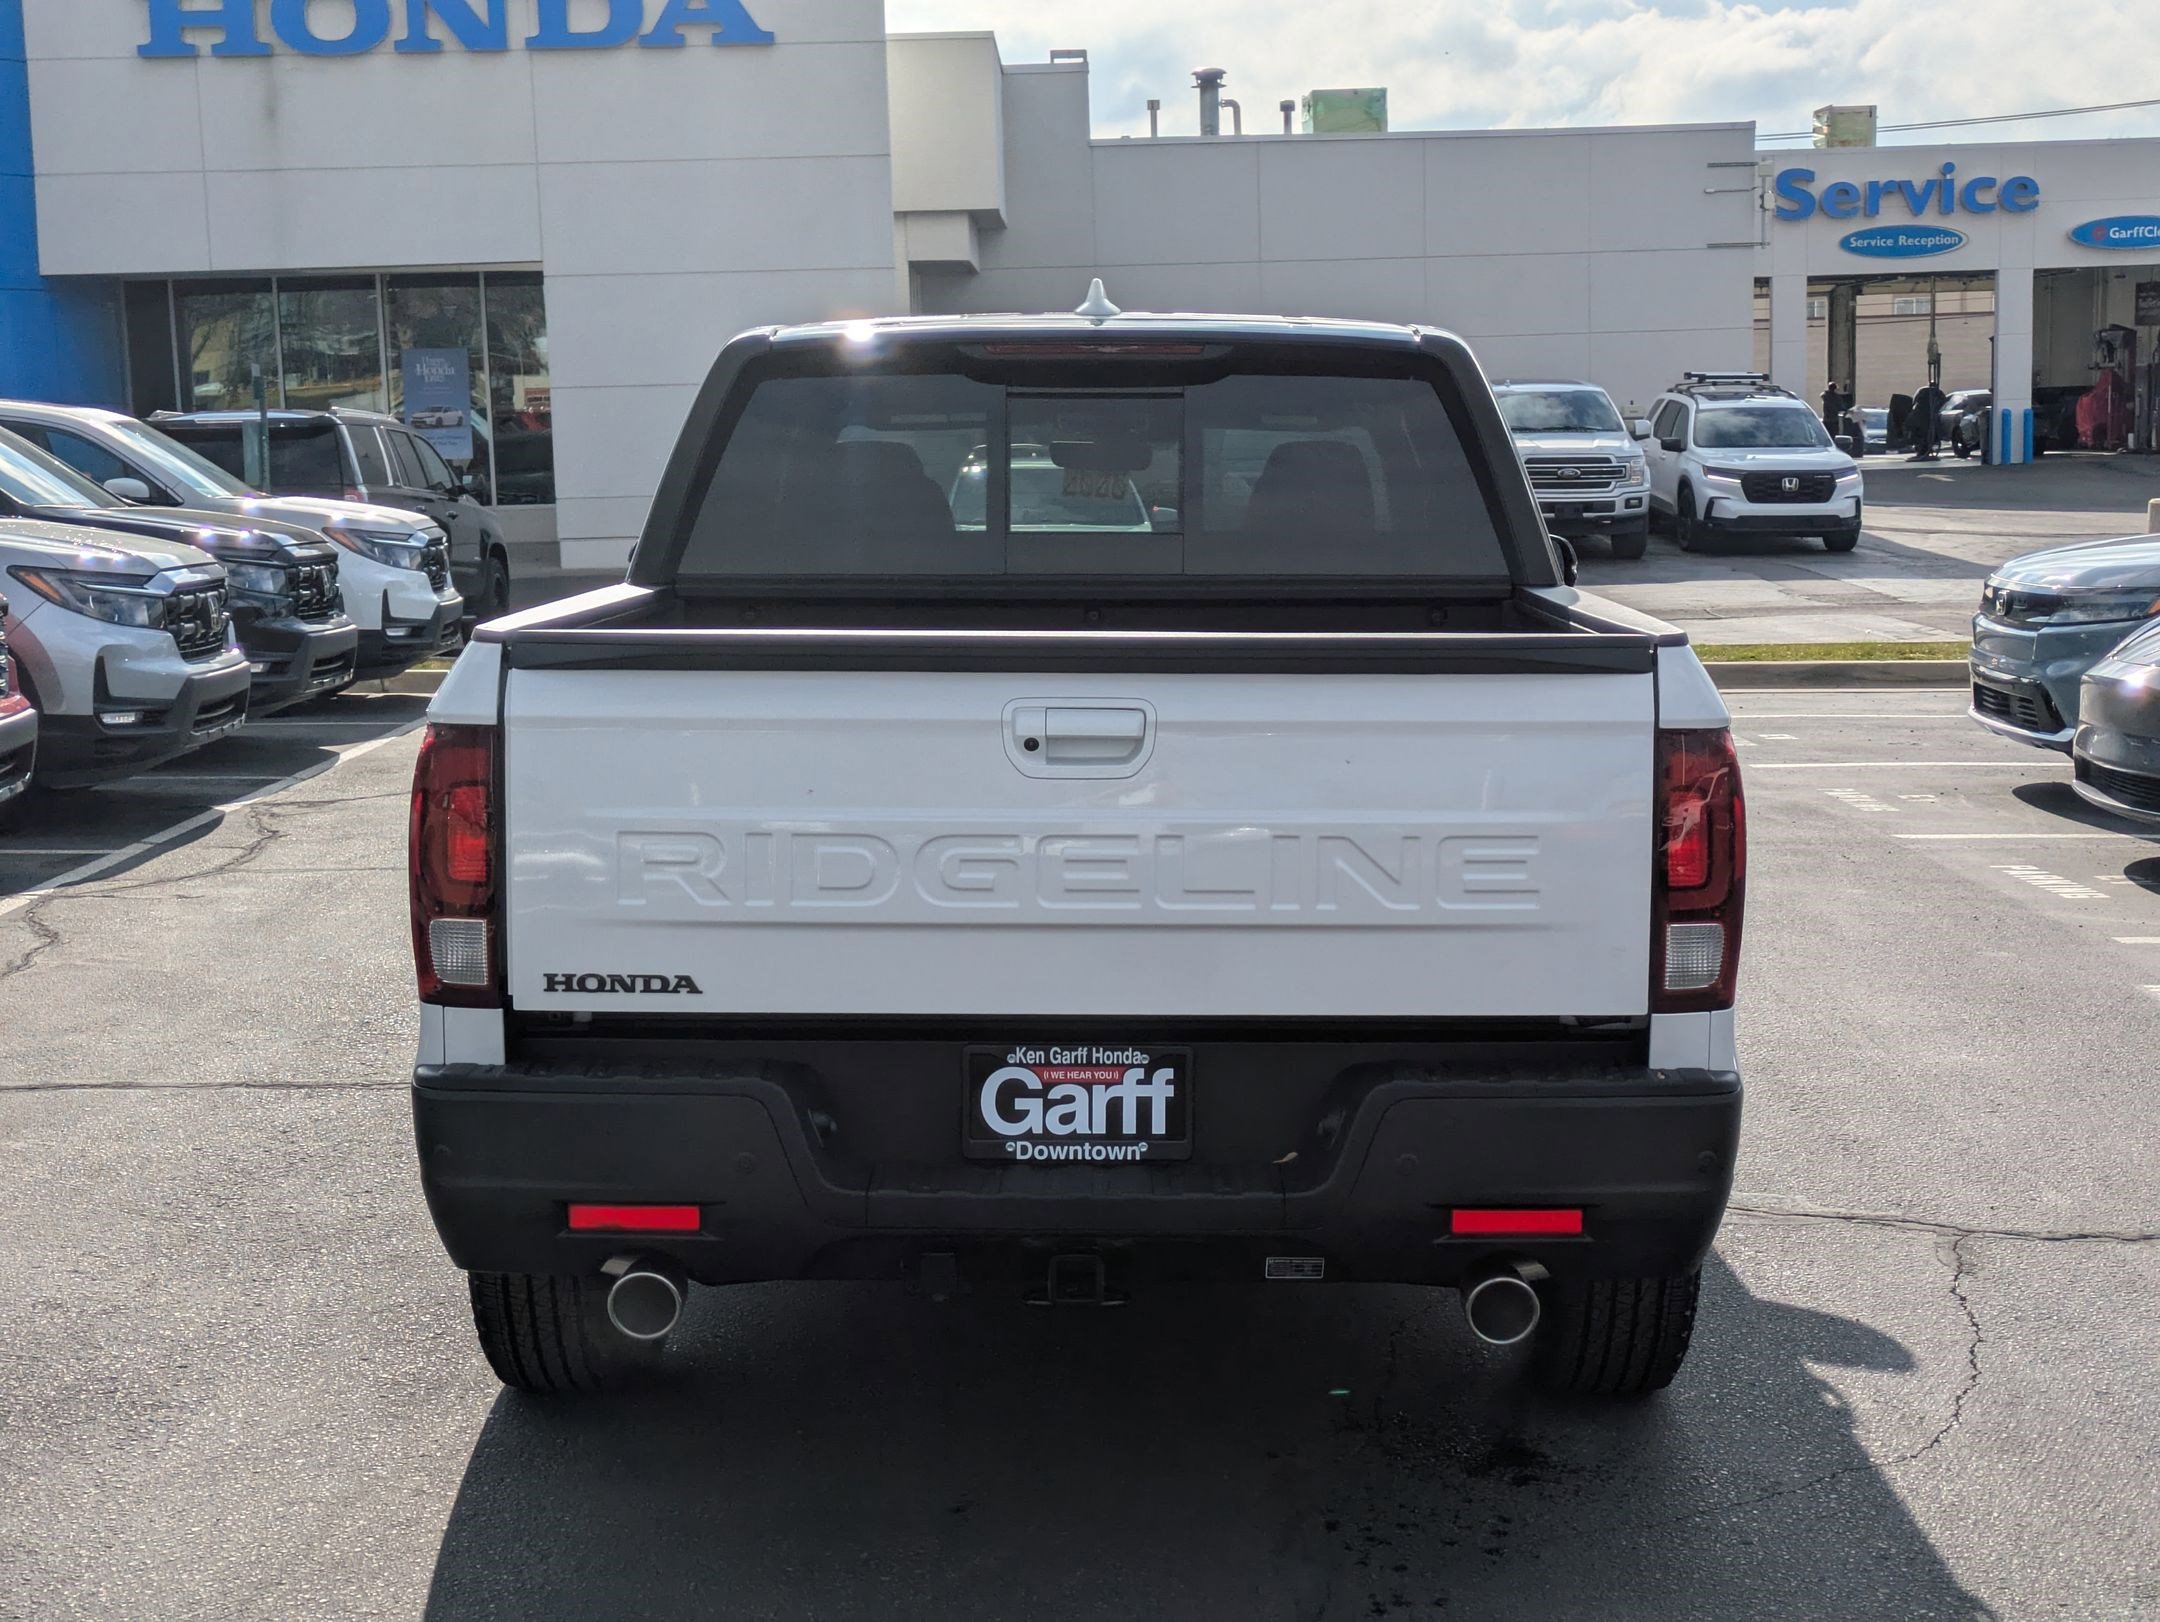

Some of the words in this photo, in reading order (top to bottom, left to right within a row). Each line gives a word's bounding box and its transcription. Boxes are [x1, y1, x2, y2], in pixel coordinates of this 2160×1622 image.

[137, 0, 775, 58] HONDA
[1775, 162, 2040, 222] Service
[1850, 236, 1894, 247] Service
[1899, 234, 1959, 248] Reception
[616, 831, 1539, 909] RIDGELINE
[543, 973, 703, 994] HONDA
[1016, 1047, 1044, 1064] Ken
[1050, 1046, 1087, 1064] Garff
[1092, 1047, 1141, 1064] Honda
[1051, 1070, 1066, 1080] WE
[1067, 1070, 1092, 1080] HEAR
[1093, 1070, 1113, 1080] YOU
[980, 1066, 1174, 1136] Garff
[1016, 1141, 1140, 1160] Downtown
